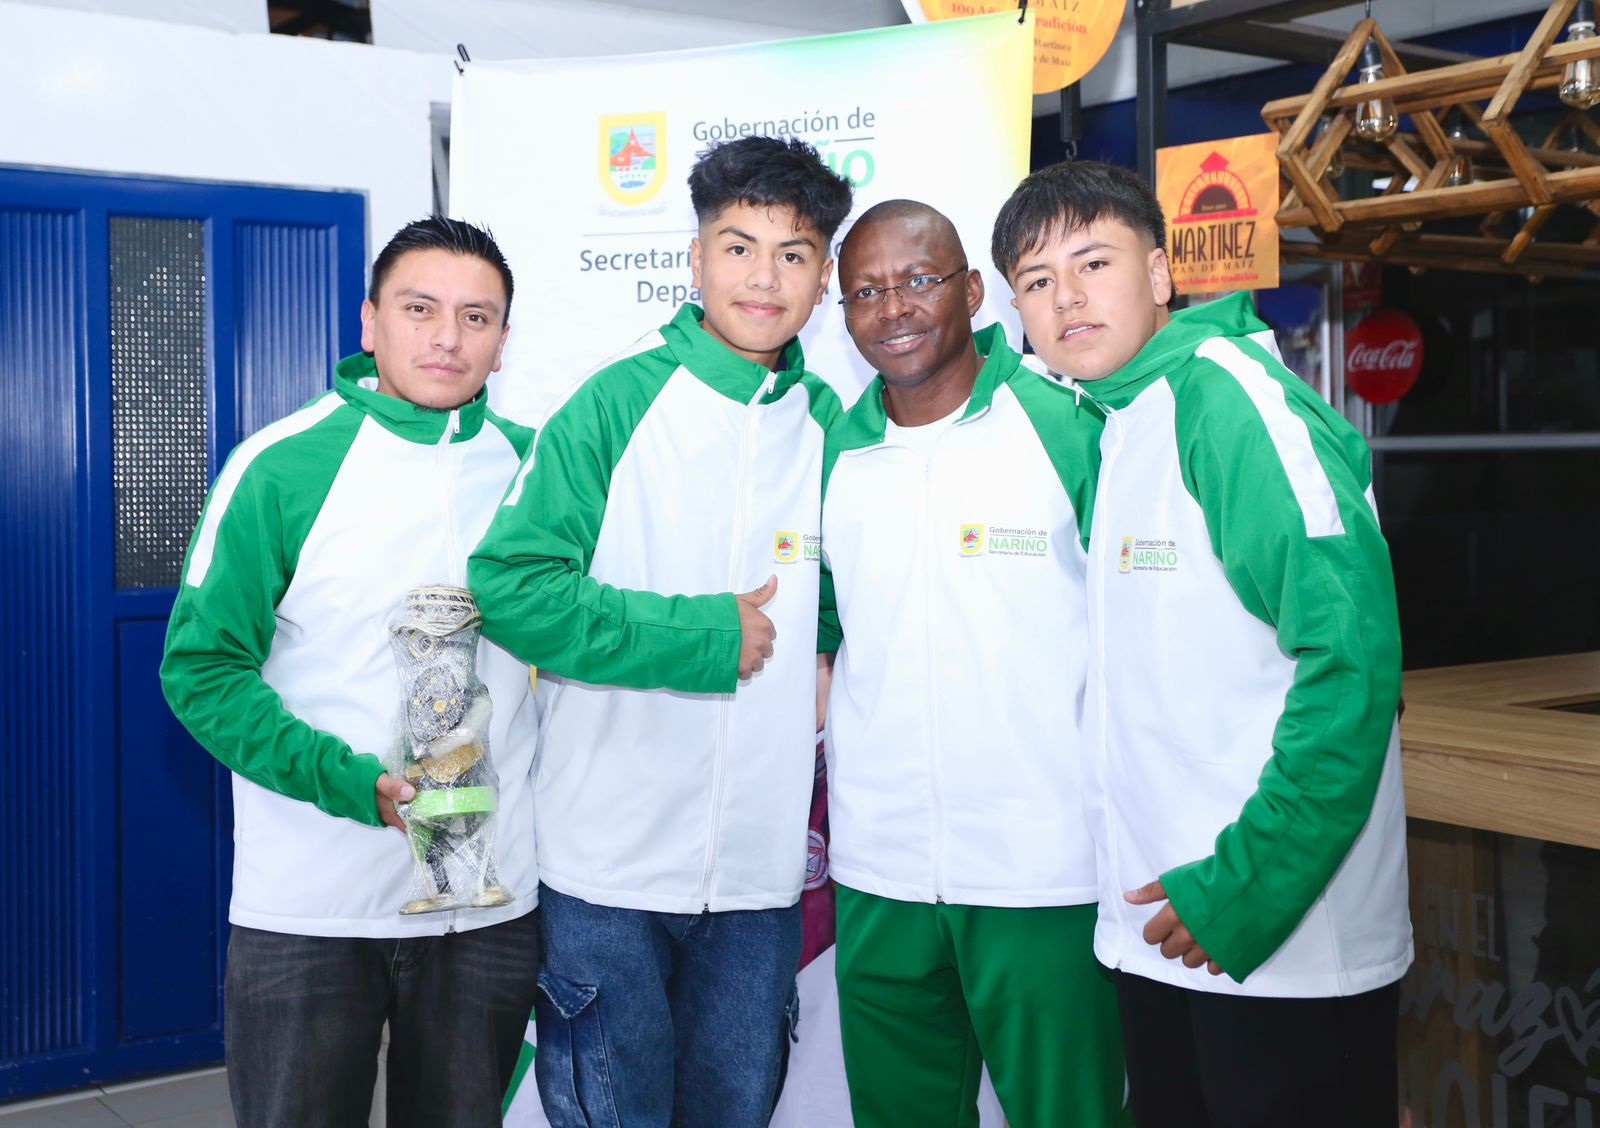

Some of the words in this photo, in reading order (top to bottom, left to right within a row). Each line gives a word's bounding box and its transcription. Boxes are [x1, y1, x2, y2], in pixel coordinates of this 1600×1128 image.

[951, 4, 975, 16] 100
[1035, 15, 1087, 34] radición
[693, 110, 839, 142] Gobernación
[847, 106, 876, 129] de
[1172, 220, 1256, 265] MARTINEZ
[989, 526, 1037, 536] Gobernación
[1471, 894, 1501, 962] EL
